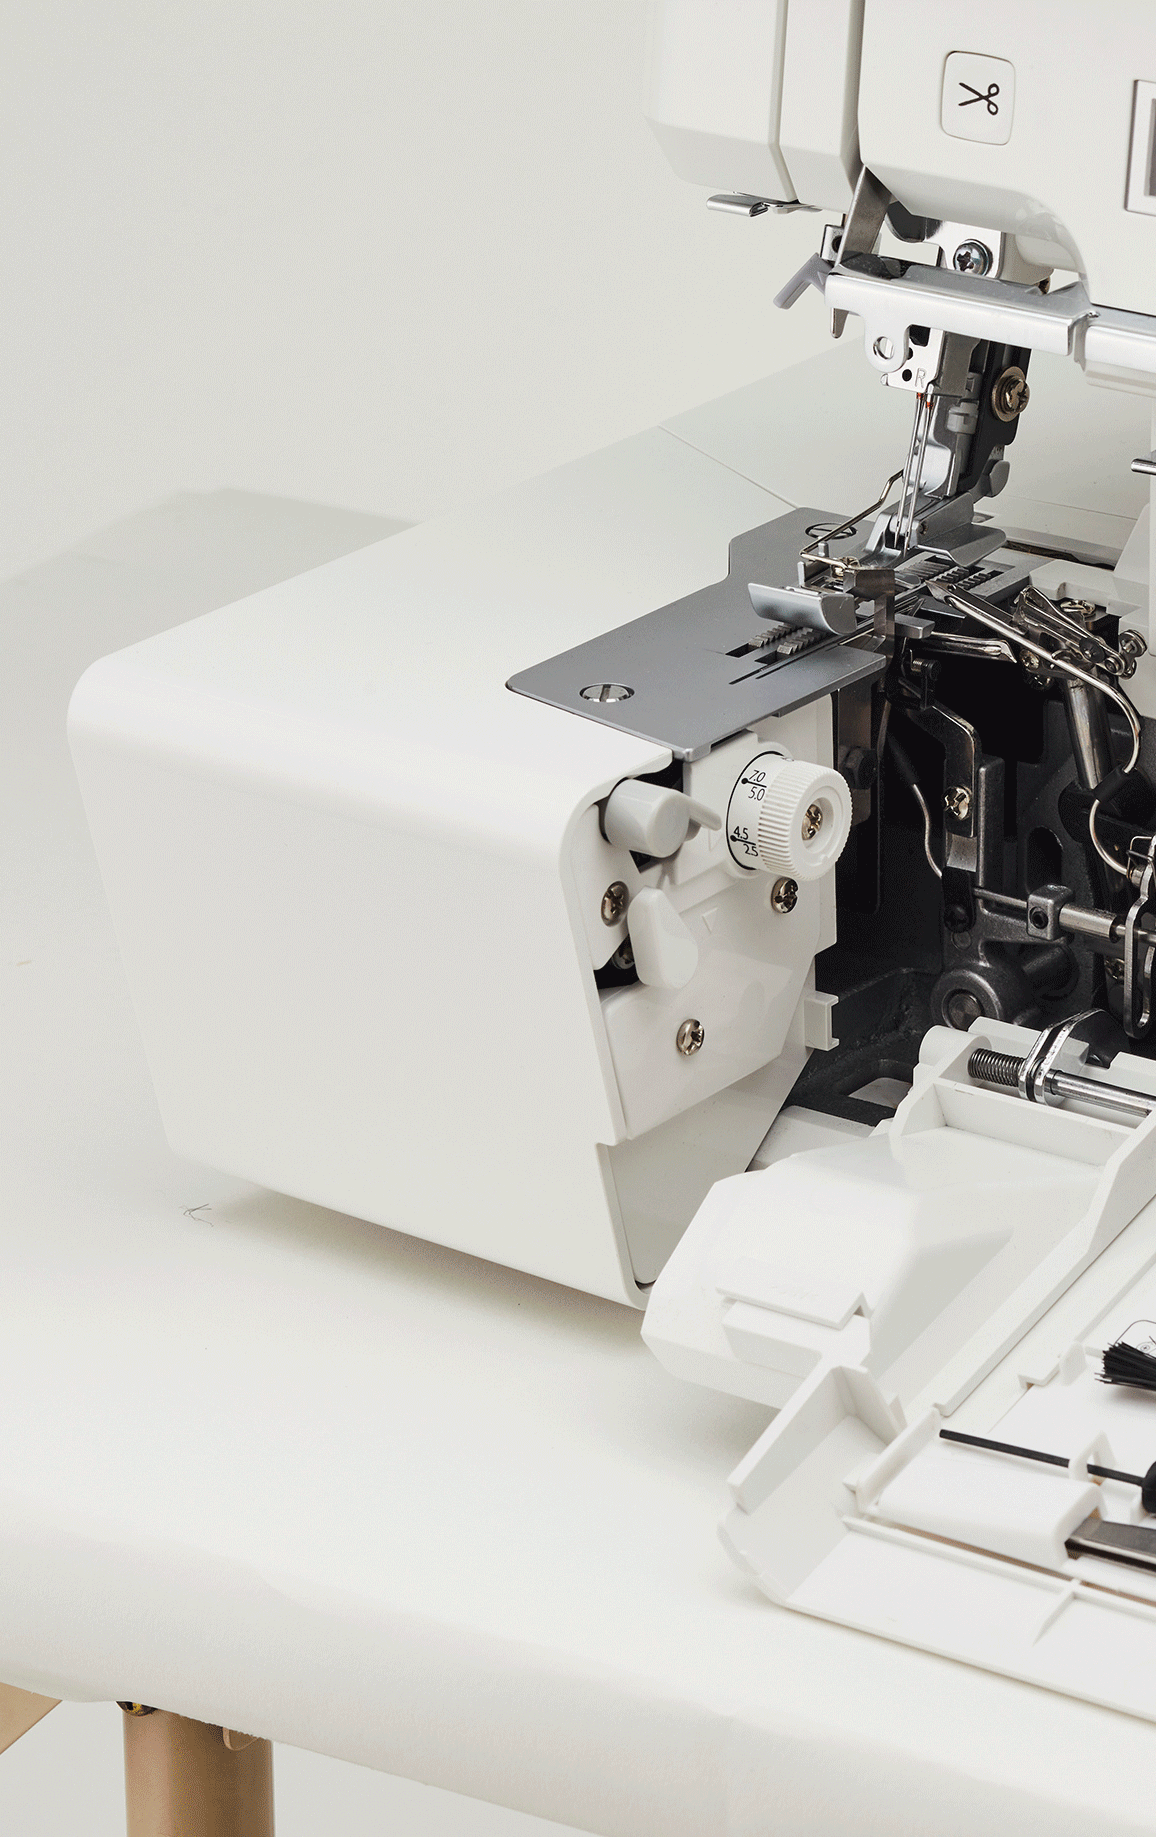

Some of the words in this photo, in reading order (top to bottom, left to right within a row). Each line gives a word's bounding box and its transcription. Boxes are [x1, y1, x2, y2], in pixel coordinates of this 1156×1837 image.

[748, 769, 766, 783] 7.0
[748, 786, 766, 801] 5.0
[733, 825, 749, 840] 4.5
